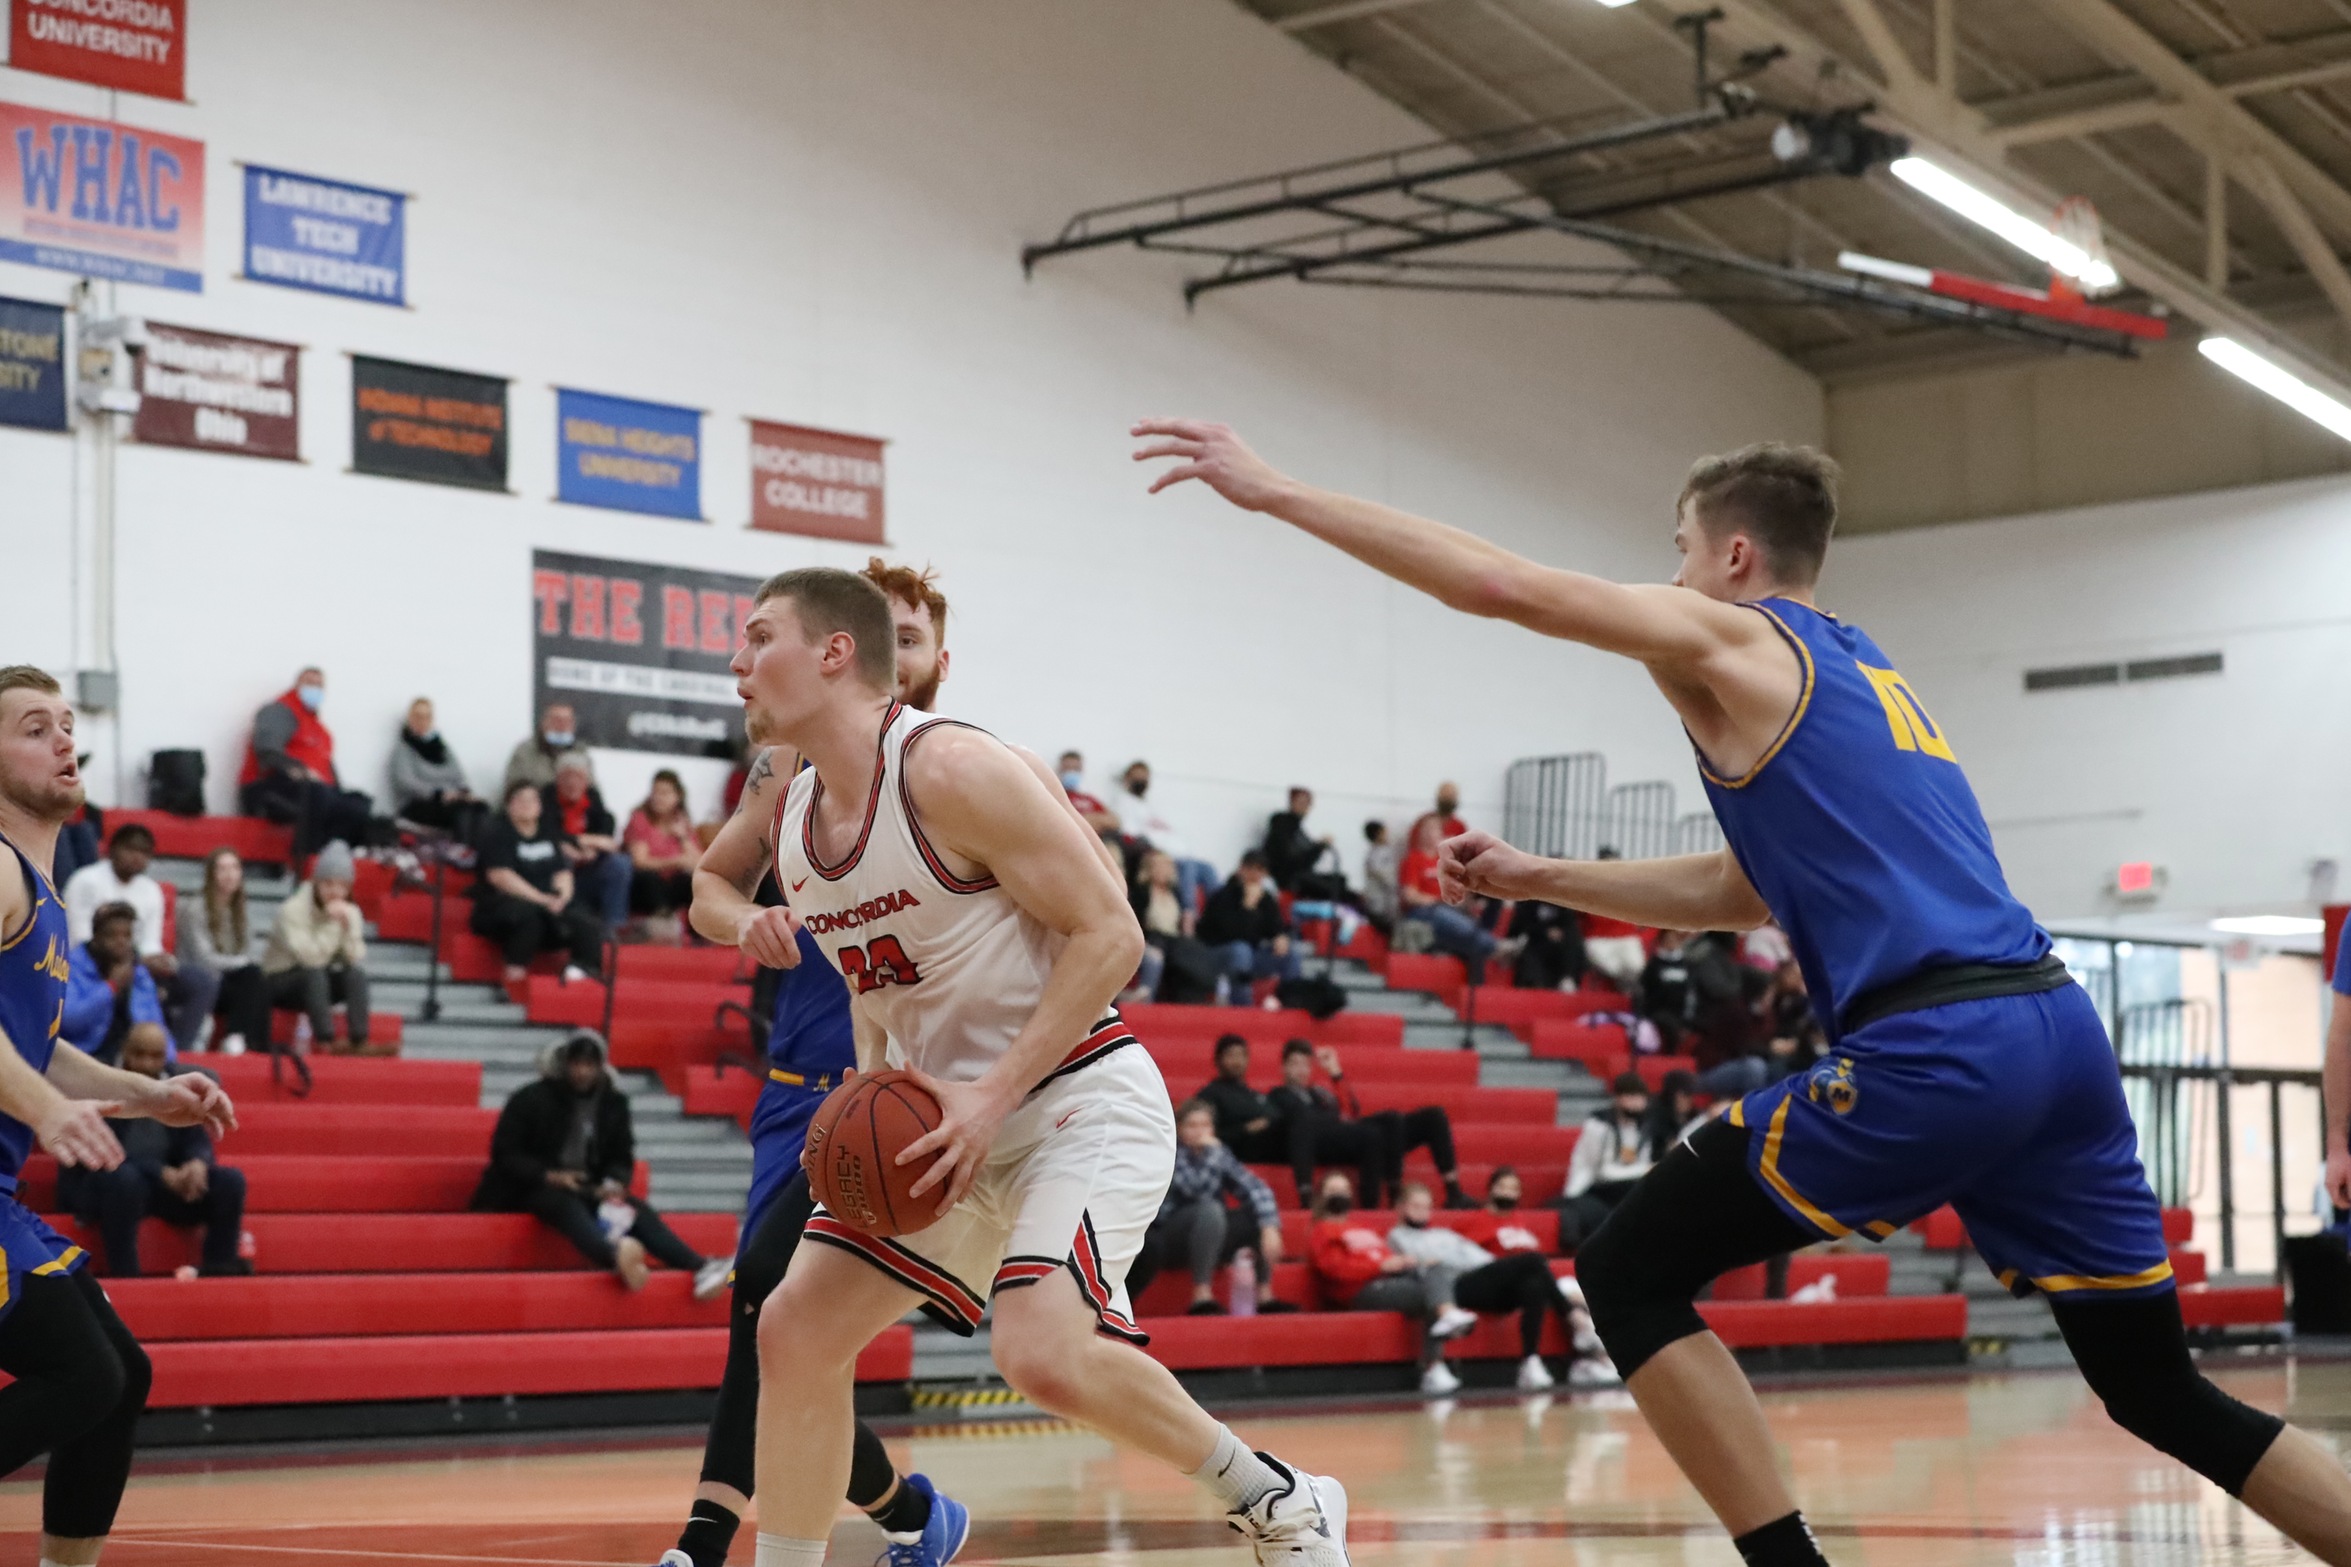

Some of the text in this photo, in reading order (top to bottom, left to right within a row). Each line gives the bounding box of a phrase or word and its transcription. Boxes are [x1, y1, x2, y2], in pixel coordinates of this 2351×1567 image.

[27, 11, 171, 65] UNIVERSITY
[28, 0, 174, 31] CORDIA
[16, 124, 182, 233] WHAC
[259, 173, 392, 226] LAWRENCE
[291, 215, 360, 256] TECH
[251, 244, 398, 297] UNIVERSITY
[752, 443, 884, 490] ROCHESTER
[764, 479, 869, 520] COLLEGE
[534, 570, 644, 647] THE
[1854, 658, 1958, 765] 10
[837, 1144, 869, 1229] LEGACY
